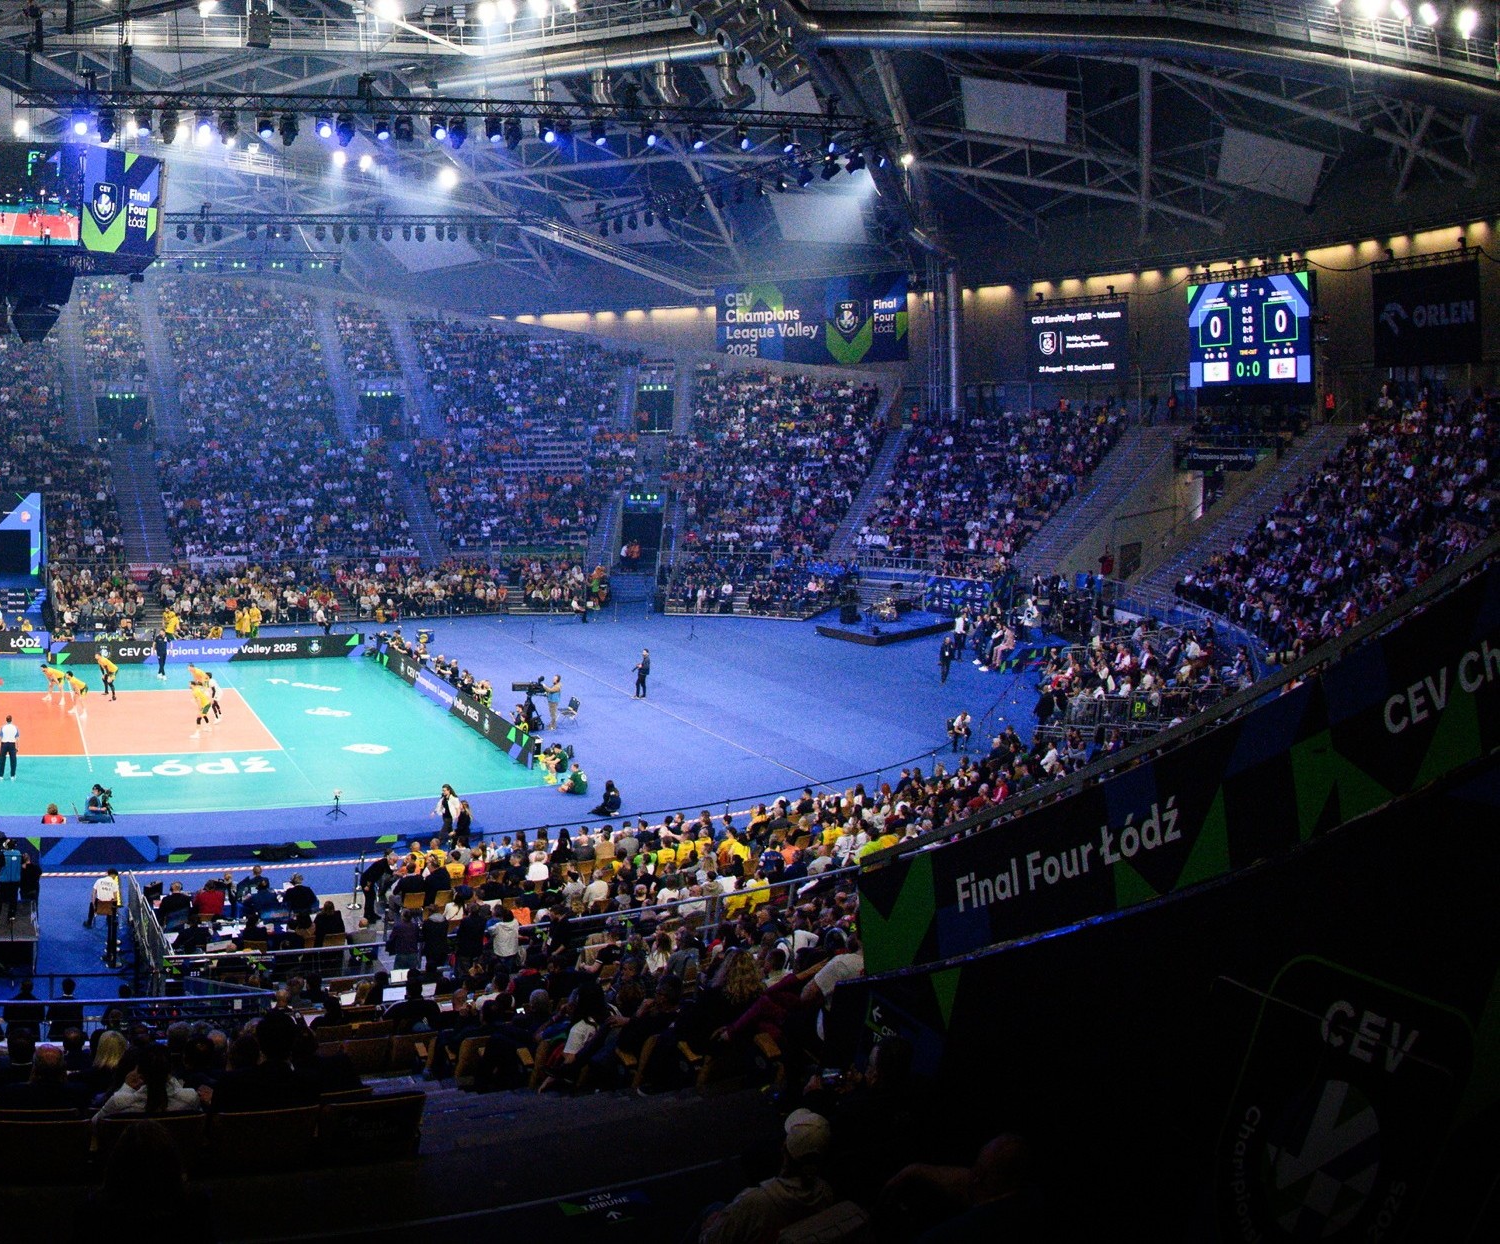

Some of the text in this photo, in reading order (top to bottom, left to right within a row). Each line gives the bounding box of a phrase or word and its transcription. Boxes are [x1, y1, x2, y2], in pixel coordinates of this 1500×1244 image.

[99, 185, 110, 193] CEV
[129, 188, 150, 202] Final
[128, 203, 148, 214] Four
[128, 214, 146, 229] Łódź
[725, 292, 753, 307] CEV
[873, 298, 897, 310] Final
[725, 309, 800, 325] Champions
[873, 313, 895, 322] Four
[1045, 313, 1076, 323] EuroVolley
[1275, 309, 1287, 333] 0
[1413, 300, 1475, 328] ORLEN
[726, 323, 819, 341] League Volley
[1210, 316, 1221, 338] 0
[726, 344, 758, 358] 2025
[1193, 453, 1220, 461] Champions
[10, 636, 41, 648] ŁÓDŹ
[119, 648, 140, 657] CEV
[202, 645, 238, 657] League
[241, 644, 271, 655] Volley
[273, 643, 297, 652] 2025
[407, 665, 479, 722] CEV Champions League Volley 2025
[1384, 666, 1447, 734] CEV
[114, 756, 276, 777] Łódź
[956, 794, 1182, 913] Final Four Łódź
[1318, 999, 1421, 1075] CEV
[589, 1192, 611, 1203] CEV
